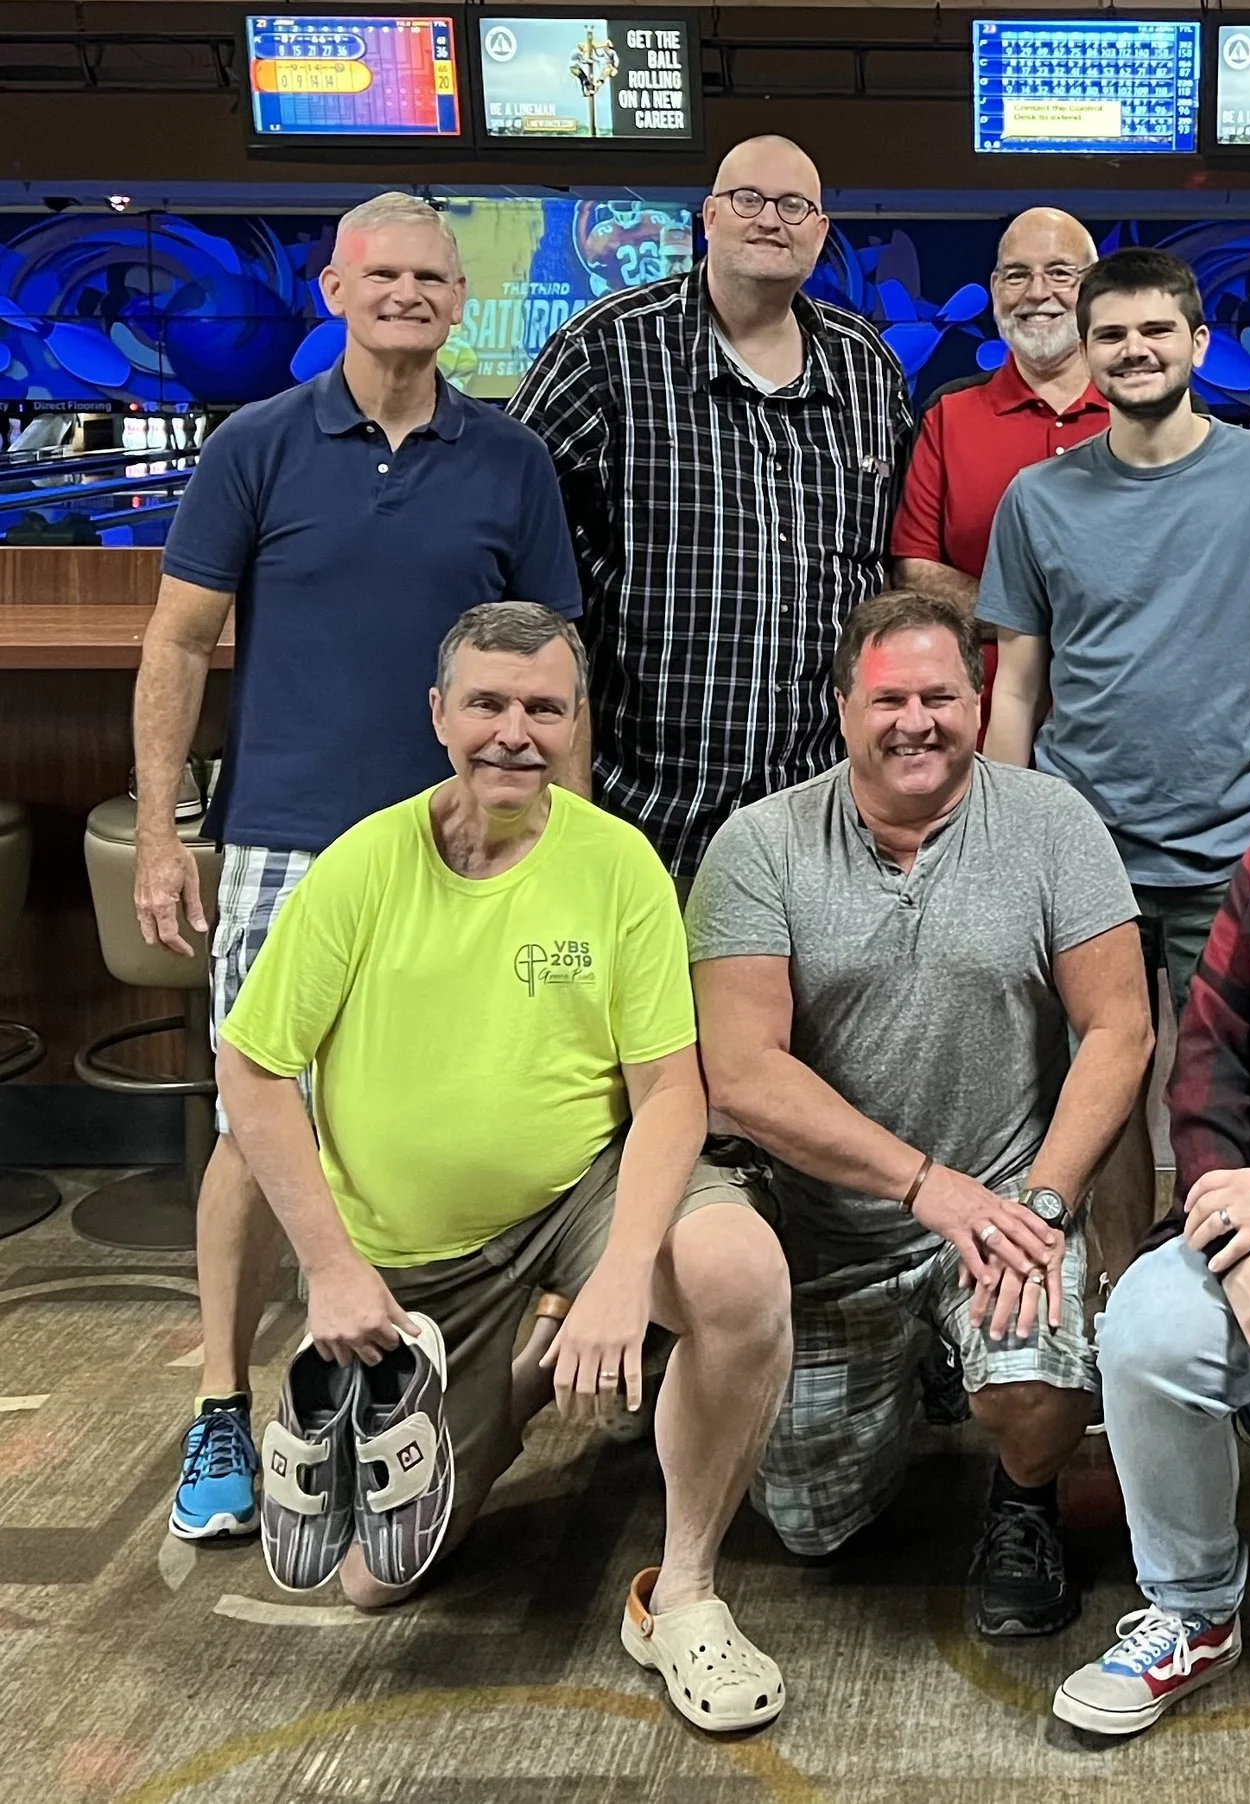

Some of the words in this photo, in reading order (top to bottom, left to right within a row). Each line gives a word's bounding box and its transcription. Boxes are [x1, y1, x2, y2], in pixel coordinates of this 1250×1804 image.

[627, 30, 652, 48] GET
[655, 31, 680, 49] THE
[648, 50, 682, 69] BALL
[282, 75, 287, 88] 0
[297, 75, 302, 88] 9
[310, 75, 318, 88] 14
[325, 75, 334, 88] 14
[439, 76, 450, 88] 20
[628, 70, 682, 89] ROLLING
[618, 90, 638, 108] ON
[640, 90, 651, 108] A
[653, 90, 682, 108] NEW
[505, 103, 512, 116] A
[635, 110, 684, 128] CAREER
[503, 282, 530, 294] THE
[530, 282, 570, 294] THIRD
[478, 361, 493, 376] IN
[34, 402, 66, 410] Direct
[68, 401, 112, 412] Flooring
[175, 402, 188, 413] 17
[554, 940, 590, 954] VBS
[551, 954, 592, 968] 2019
